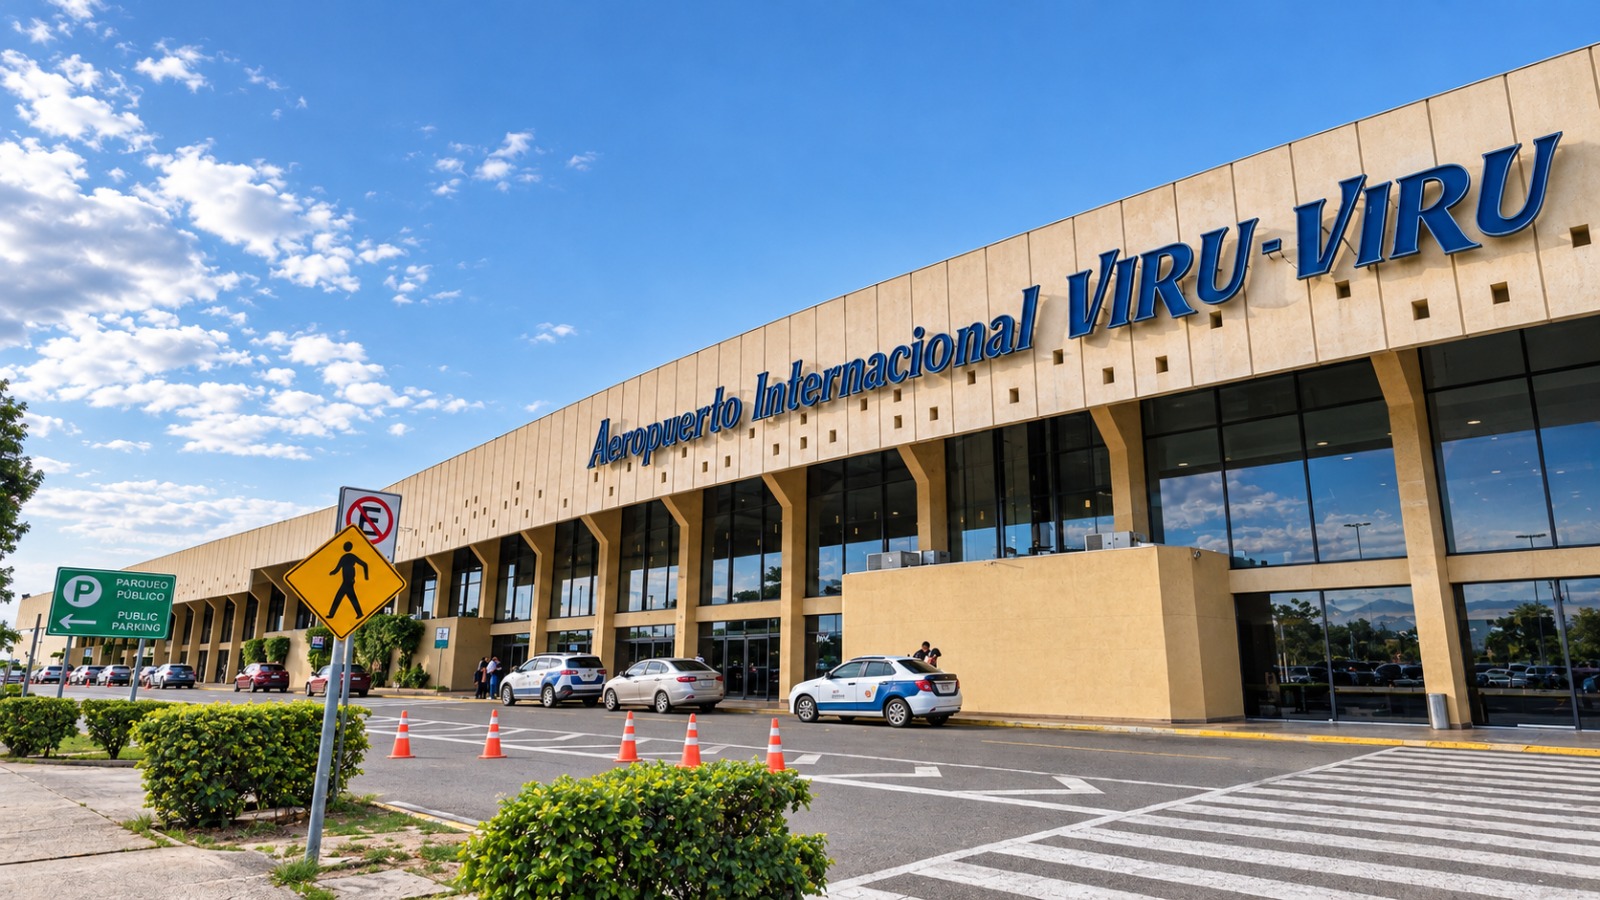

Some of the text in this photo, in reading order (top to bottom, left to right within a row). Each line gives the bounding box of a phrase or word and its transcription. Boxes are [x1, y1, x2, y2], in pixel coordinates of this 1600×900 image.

[587, 131, 1563, 468] Aeropuerto Internacional VIRU-VIRU
[359, 506, 381, 536] E
[116, 578, 168, 590] PARQUEO
[73, 580, 95, 602] P
[117, 589, 165, 601] PÚBLICO
[118, 611, 158, 621] PUBLIC
[112, 622, 160, 632] PARKING
